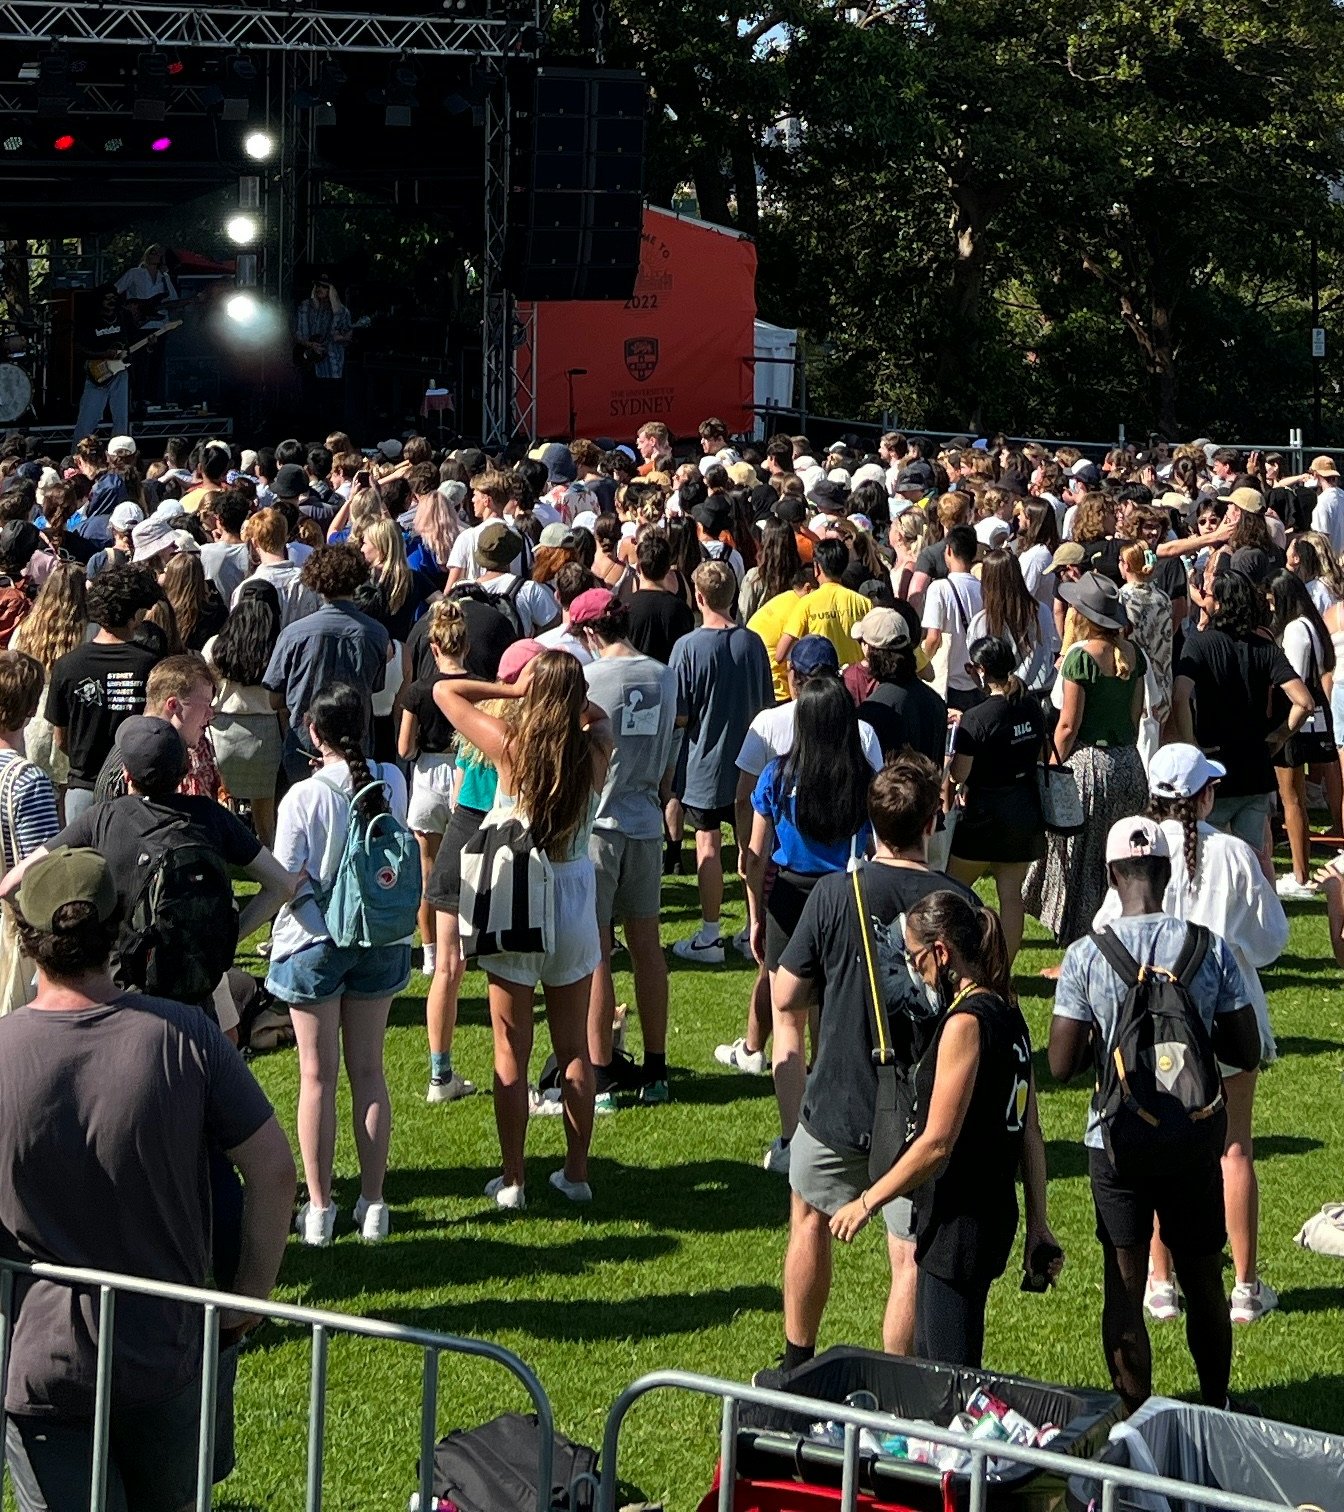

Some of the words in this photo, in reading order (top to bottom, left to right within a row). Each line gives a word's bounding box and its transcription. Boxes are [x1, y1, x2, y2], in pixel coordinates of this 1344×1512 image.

[660, 242, 670, 259] TO
[624, 295, 658, 310] 2022
[610, 396, 674, 416] SYDNEY
[818, 611, 836, 620] USU
